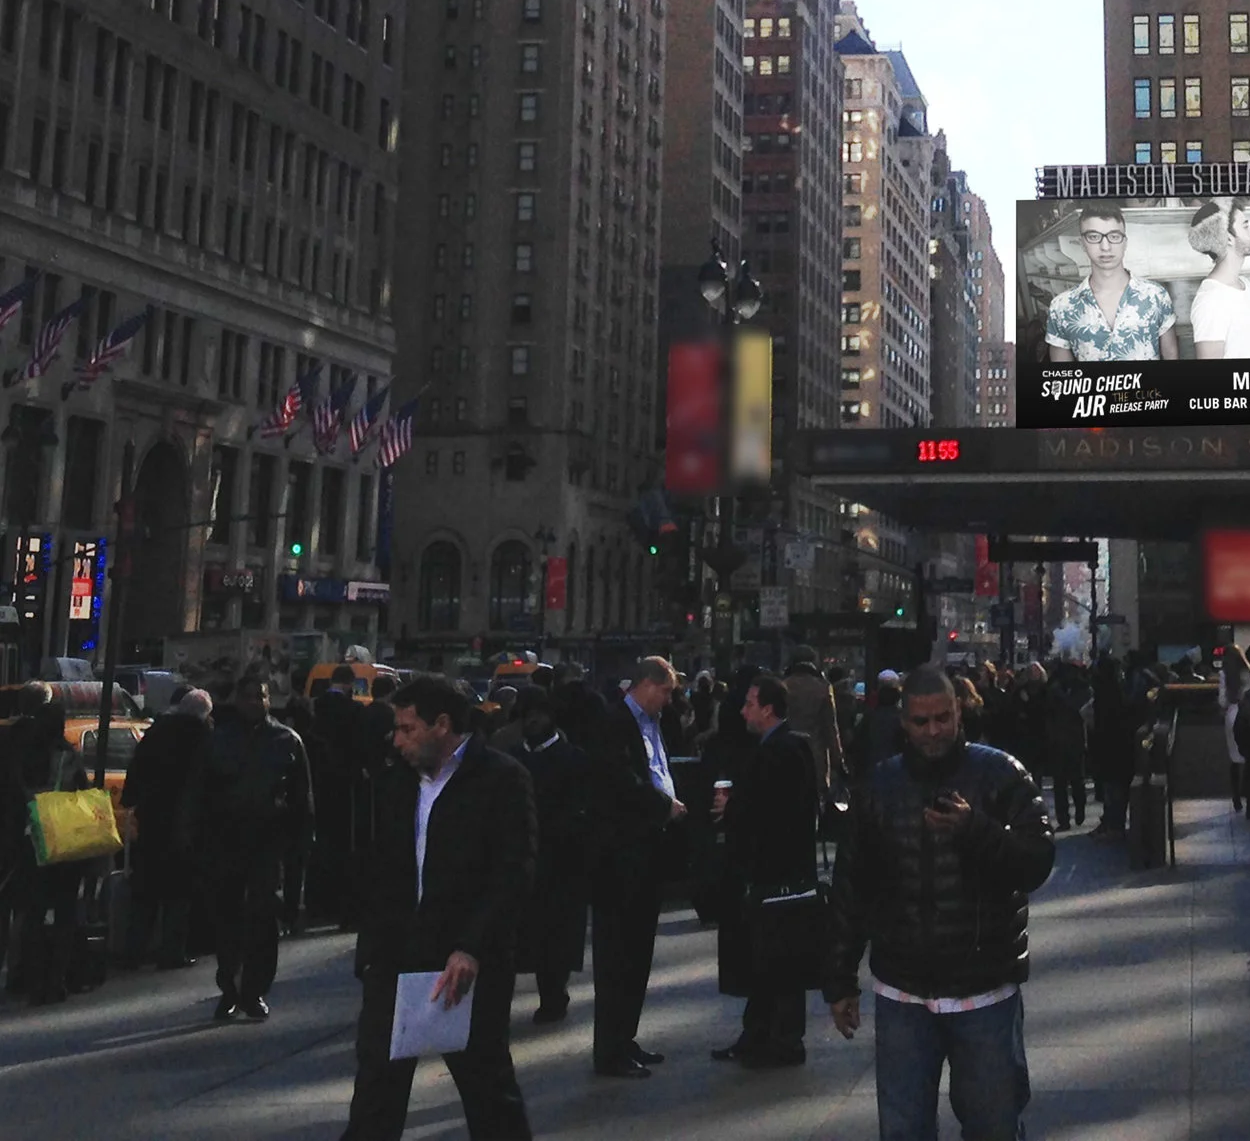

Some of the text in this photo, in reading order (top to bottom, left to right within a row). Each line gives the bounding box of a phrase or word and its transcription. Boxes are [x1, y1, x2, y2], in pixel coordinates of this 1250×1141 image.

[1056, 164, 1177, 197] MADISON
[1095, 373, 1142, 392] CHECK
[1112, 388, 1162, 402] THE CLICK
[1189, 398, 1220, 409] CLUB
[1224, 397, 1248, 409] BAR
[1072, 394, 1107, 418] AJR
[1109, 399, 1169, 413] RELEASE PARTY
[1045, 437, 1222, 457] MADISON
